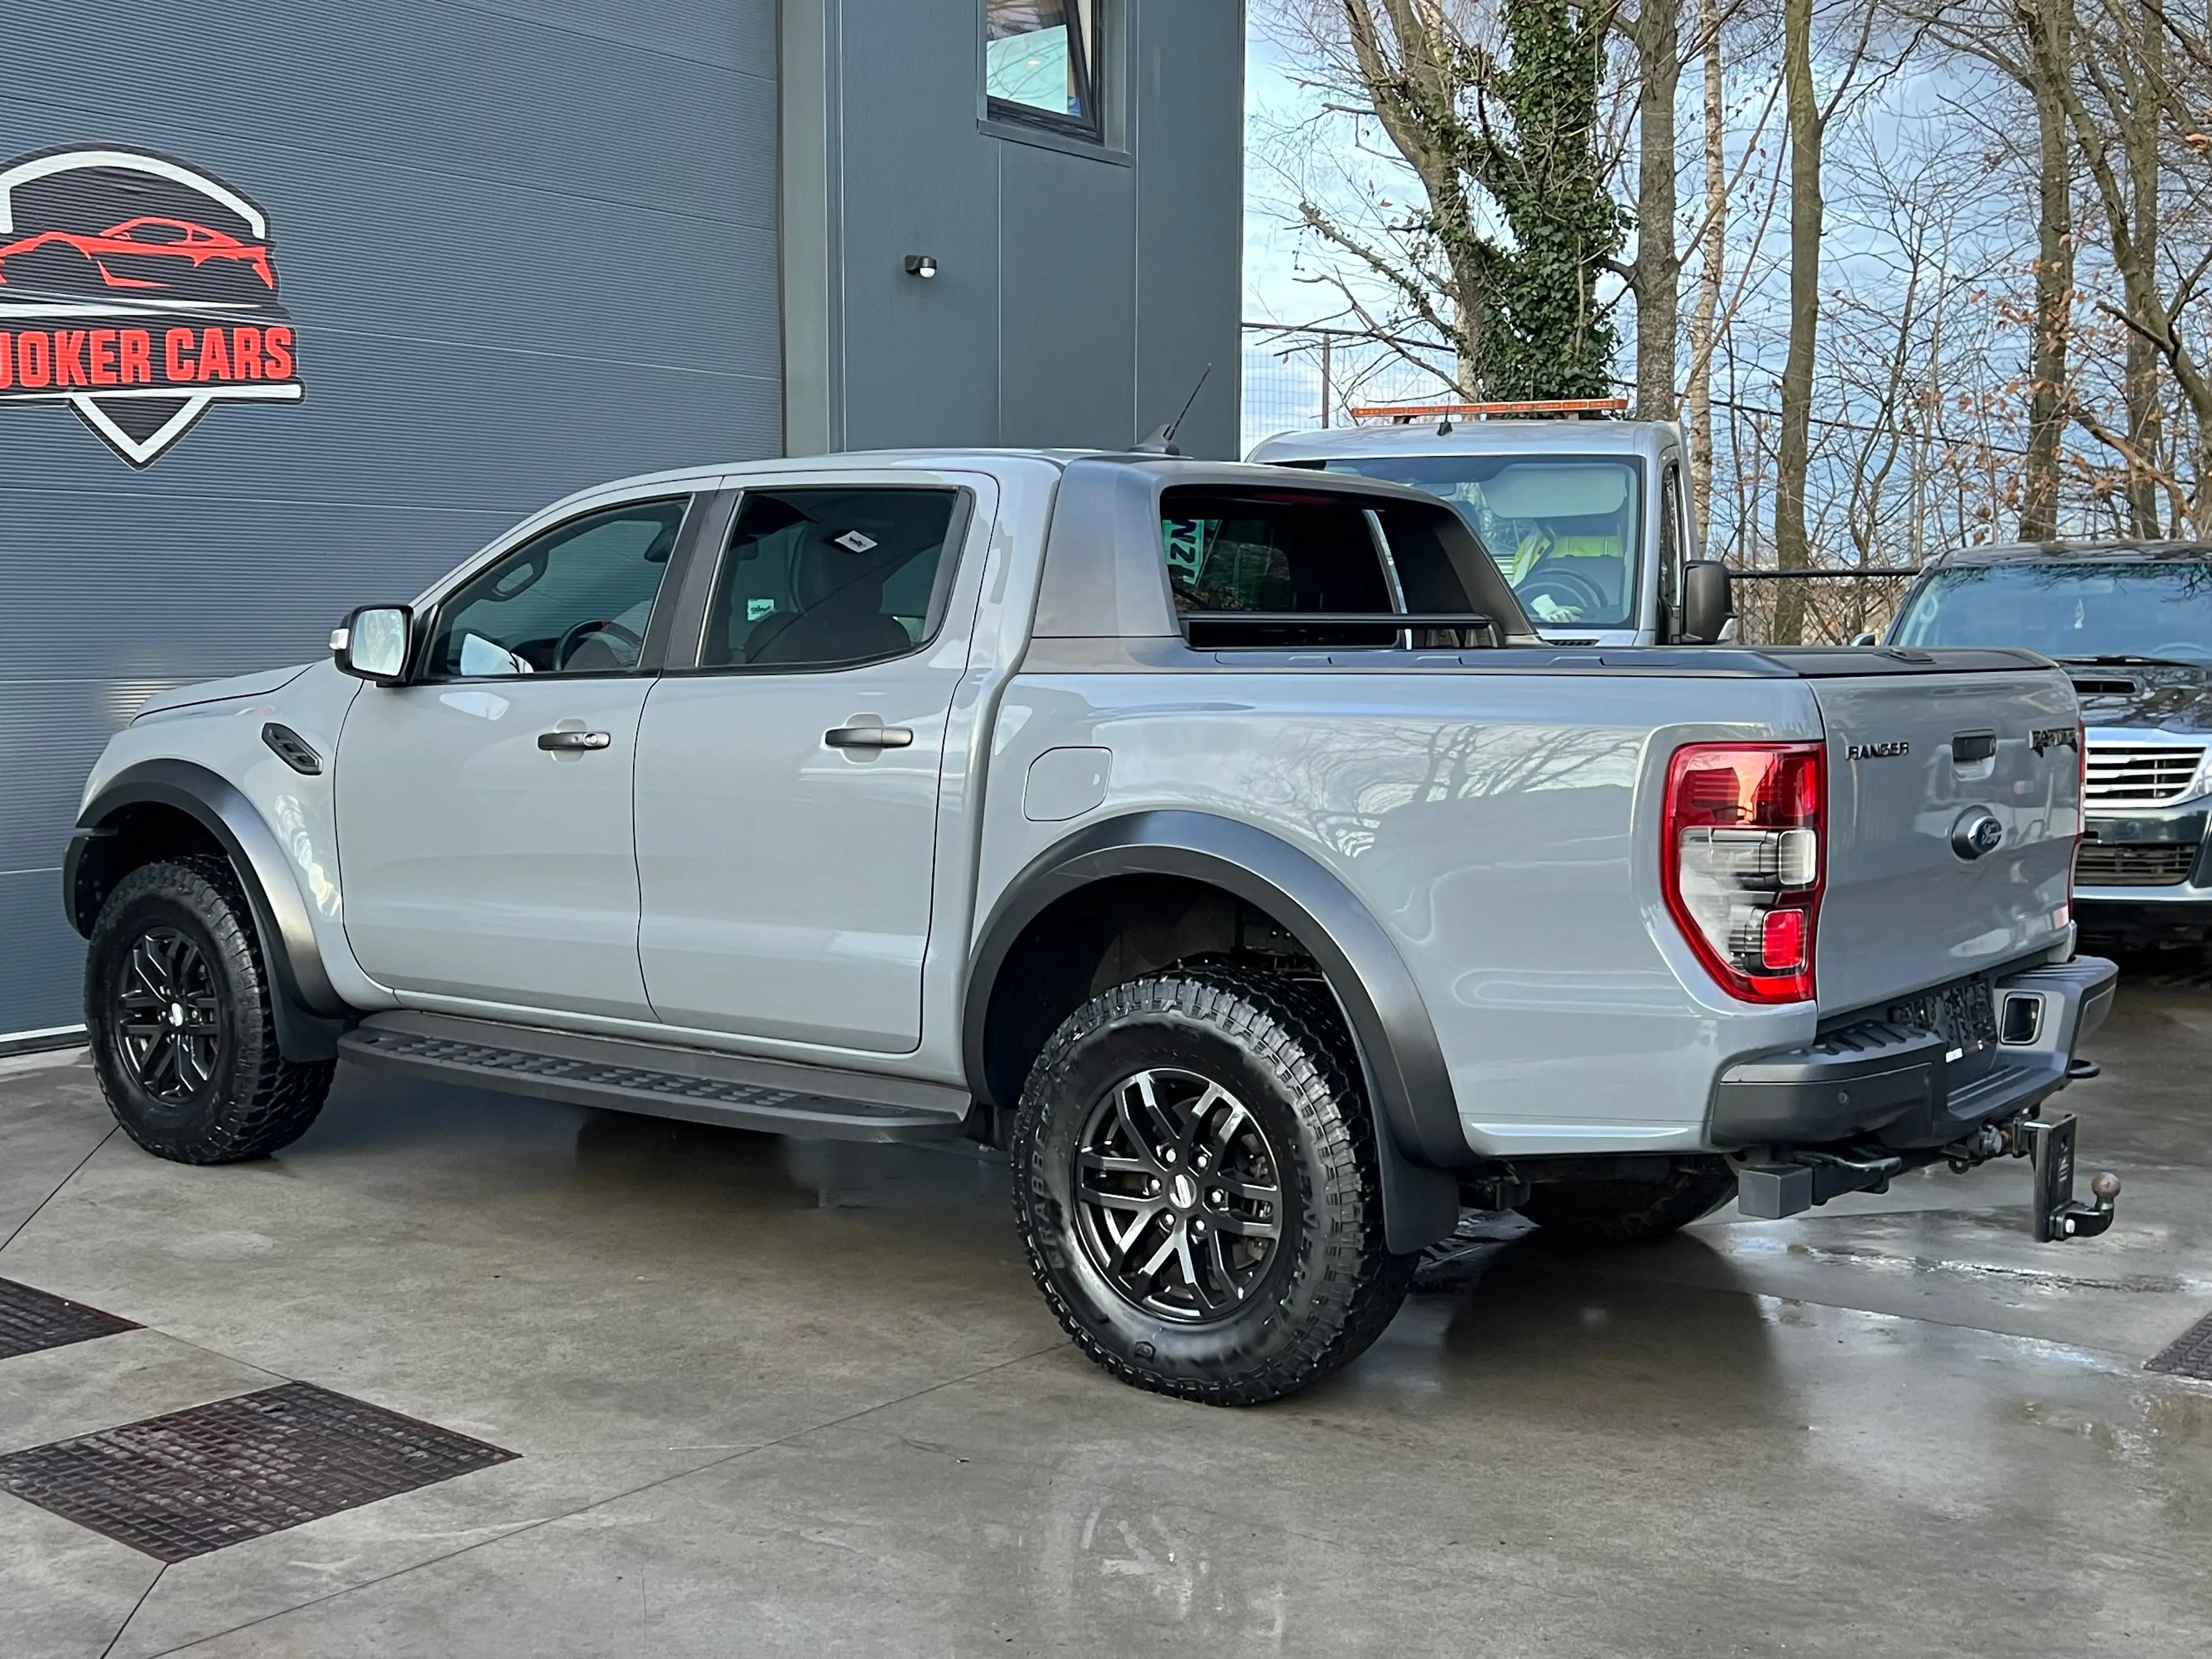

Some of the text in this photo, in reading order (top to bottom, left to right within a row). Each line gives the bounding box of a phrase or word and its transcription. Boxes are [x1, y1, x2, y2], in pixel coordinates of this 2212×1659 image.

[165, 327, 291, 381] CARS
[1845, 742, 1909, 760] RANGER
[1032, 1103, 1065, 1268] GRABBER
